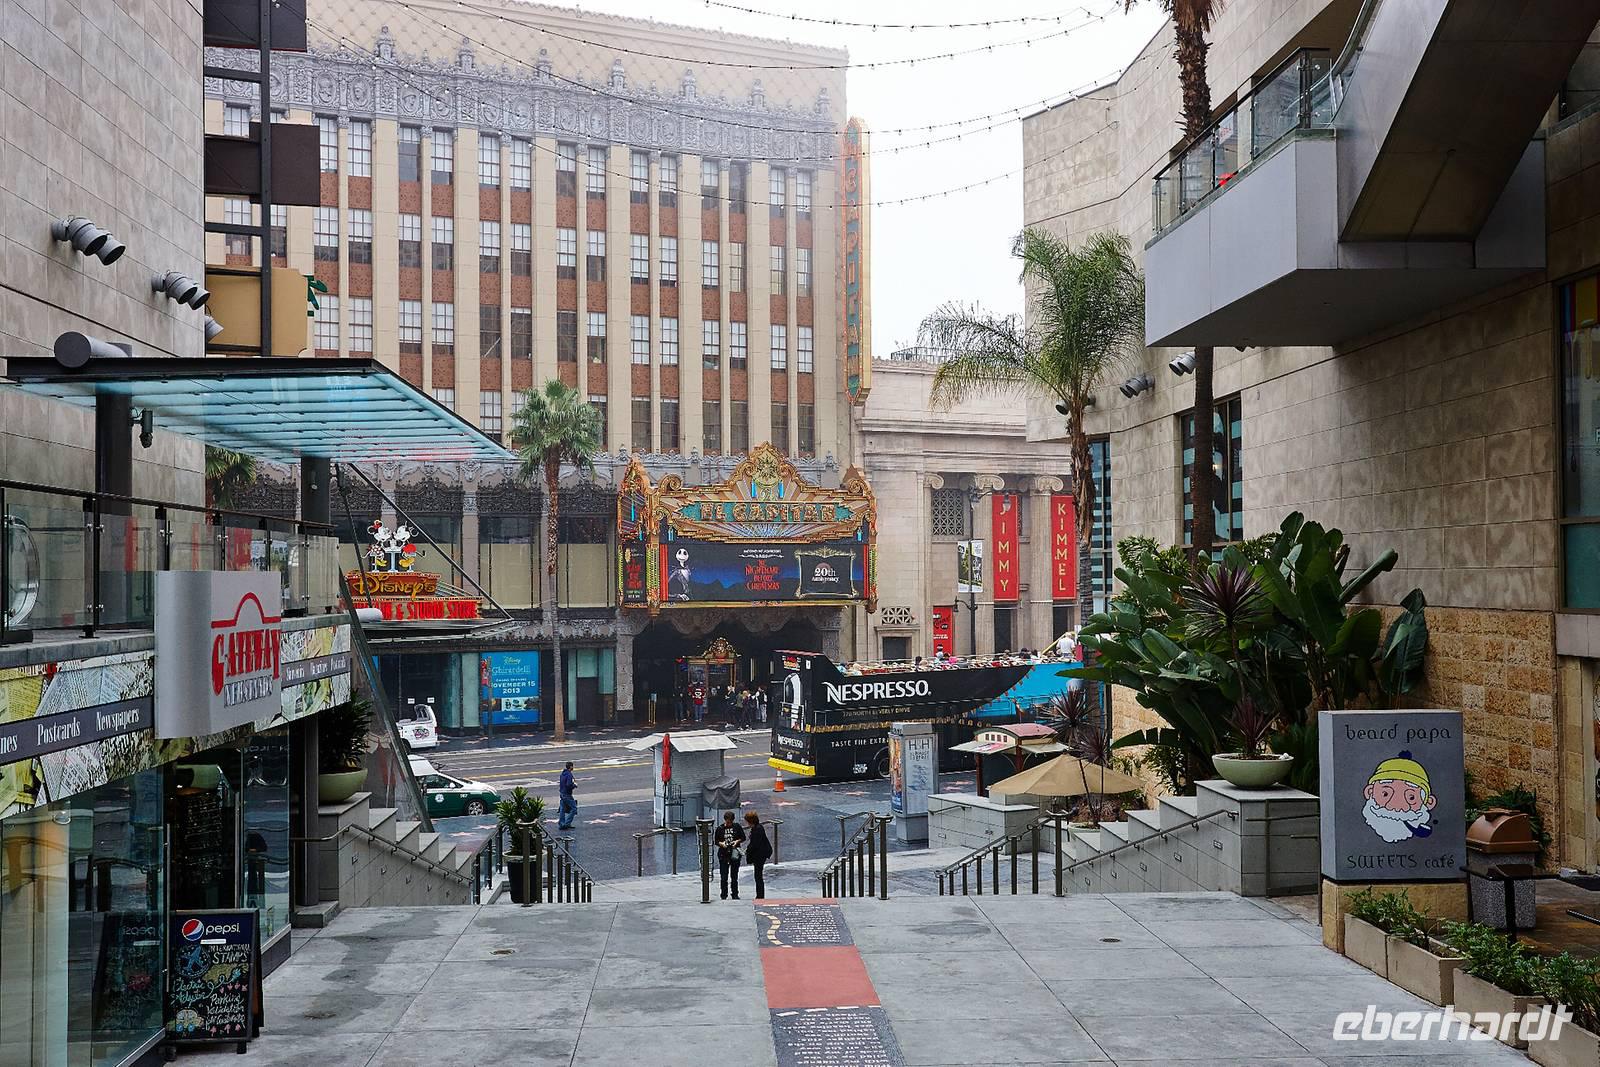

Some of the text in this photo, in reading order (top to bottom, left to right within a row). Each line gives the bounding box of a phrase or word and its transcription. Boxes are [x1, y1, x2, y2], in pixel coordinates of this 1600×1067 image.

[733, 502, 837, 521] CAPITAN
[998, 502, 1010, 592] JIMMY
[1056, 503, 1068, 591] KIMMEL
[811, 576, 840, 584] Anniversary
[814, 567, 836, 577] 20th
[407, 601, 444, 620] STUDIO
[446, 601, 477, 619] STORE
[212, 629, 281, 697] GATEWAY
[37, 716, 81, 747] Postcards
[96, 708, 141, 733] Newspapers
[1345, 724, 1452, 744] beard papa
[831, 740, 851, 748] TASTE
[1424, 855, 1456, 869] café
[205, 923, 239, 935] pepsi
[212, 952, 249, 964] STAMPS
